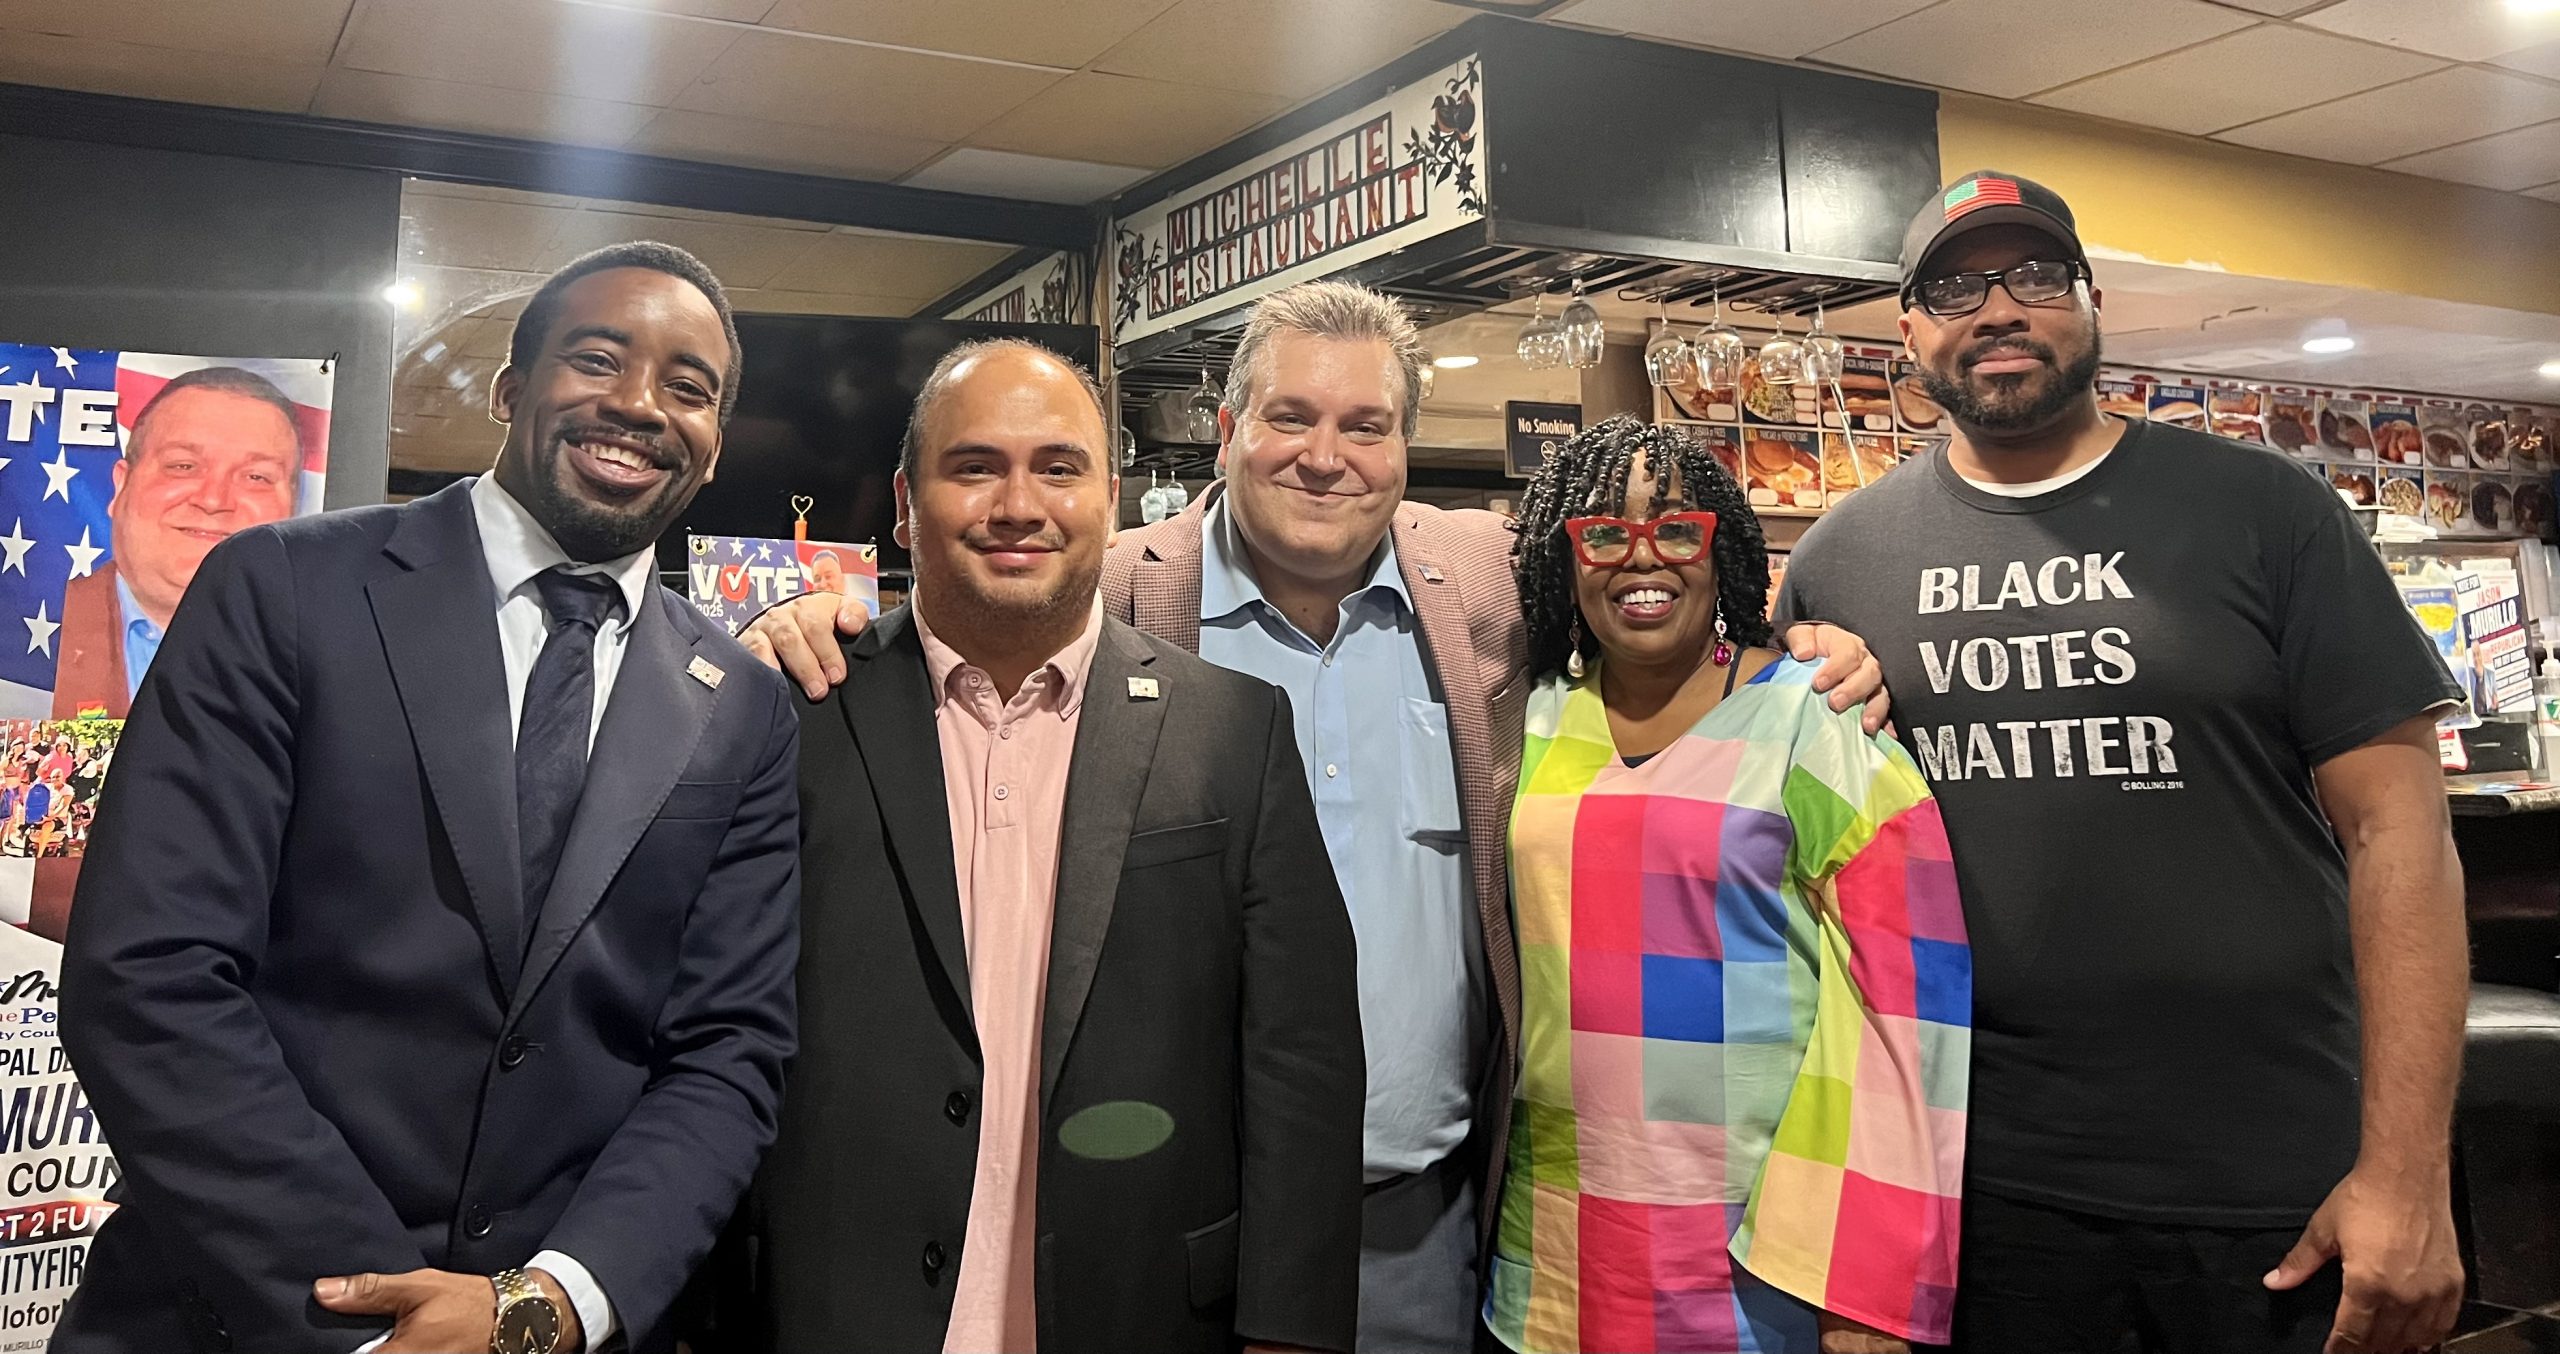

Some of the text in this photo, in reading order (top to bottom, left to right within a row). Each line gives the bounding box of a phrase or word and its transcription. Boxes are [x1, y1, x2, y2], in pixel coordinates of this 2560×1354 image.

[1168, 120, 1387, 252] MICHELLE
[1150, 165, 1420, 313] RESTAURANT
[1518, 418, 1575, 438] No Smoking
[691, 553, 800, 602] VOTE
[1918, 551, 2135, 615] BLACK
[2469, 599, 2518, 639] MURILLO
[1918, 627, 2137, 694] VOTES
[1912, 716, 2178, 781] MATTER
[20, 1030, 60, 1038] Cou
[0, 1081, 109, 1153] MUR
[29, 1211, 46, 1238] 2
[0, 1244, 85, 1296] ITYFIR
[3, 1339, 44, 1352] MURILLO
